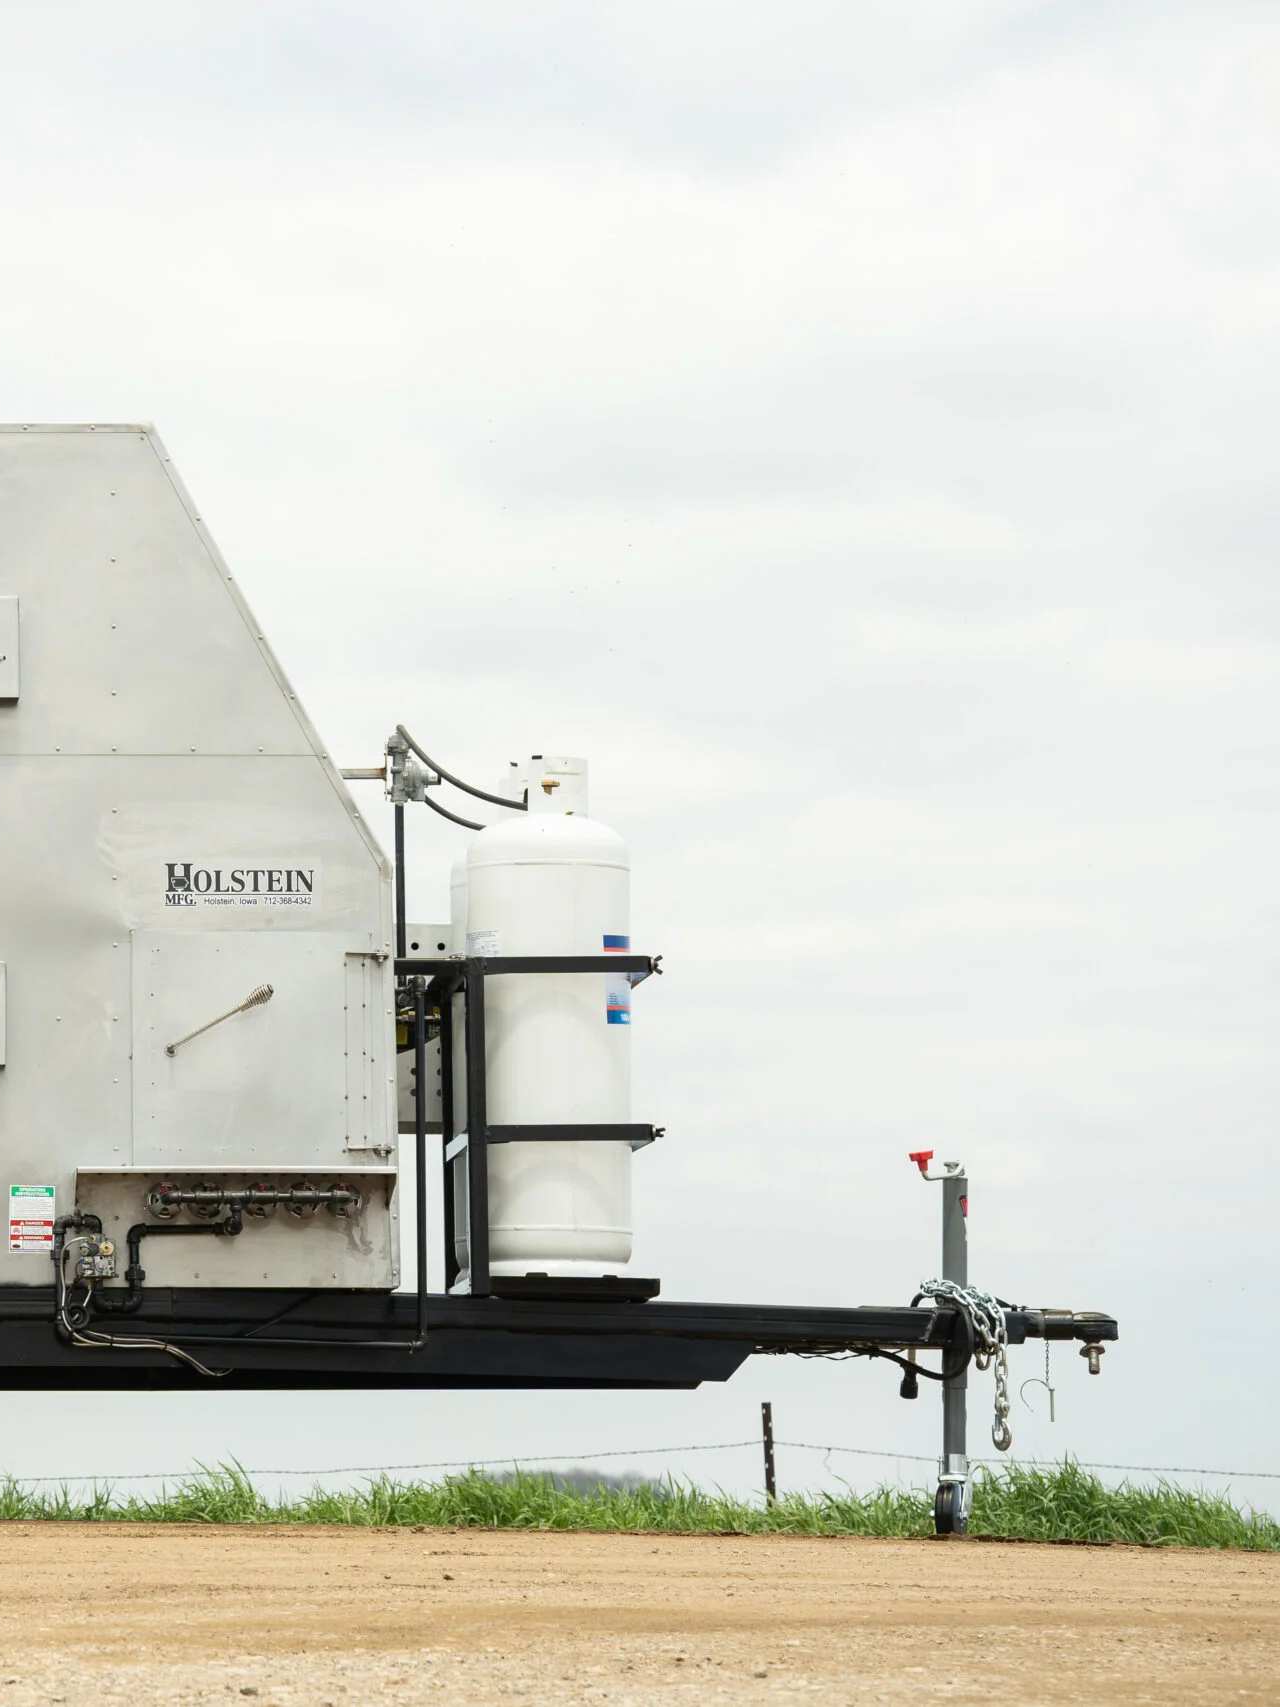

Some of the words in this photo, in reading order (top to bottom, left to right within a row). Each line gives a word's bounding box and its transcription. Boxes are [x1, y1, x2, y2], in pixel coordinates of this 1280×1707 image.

[164, 863, 315, 893] HOLSTEIN
[165, 893, 197, 905] MFG.
[204, 897, 237, 906] Holstein,
[239, 897, 258, 905] Iowa
[263, 896, 312, 905] 712-368-4342
